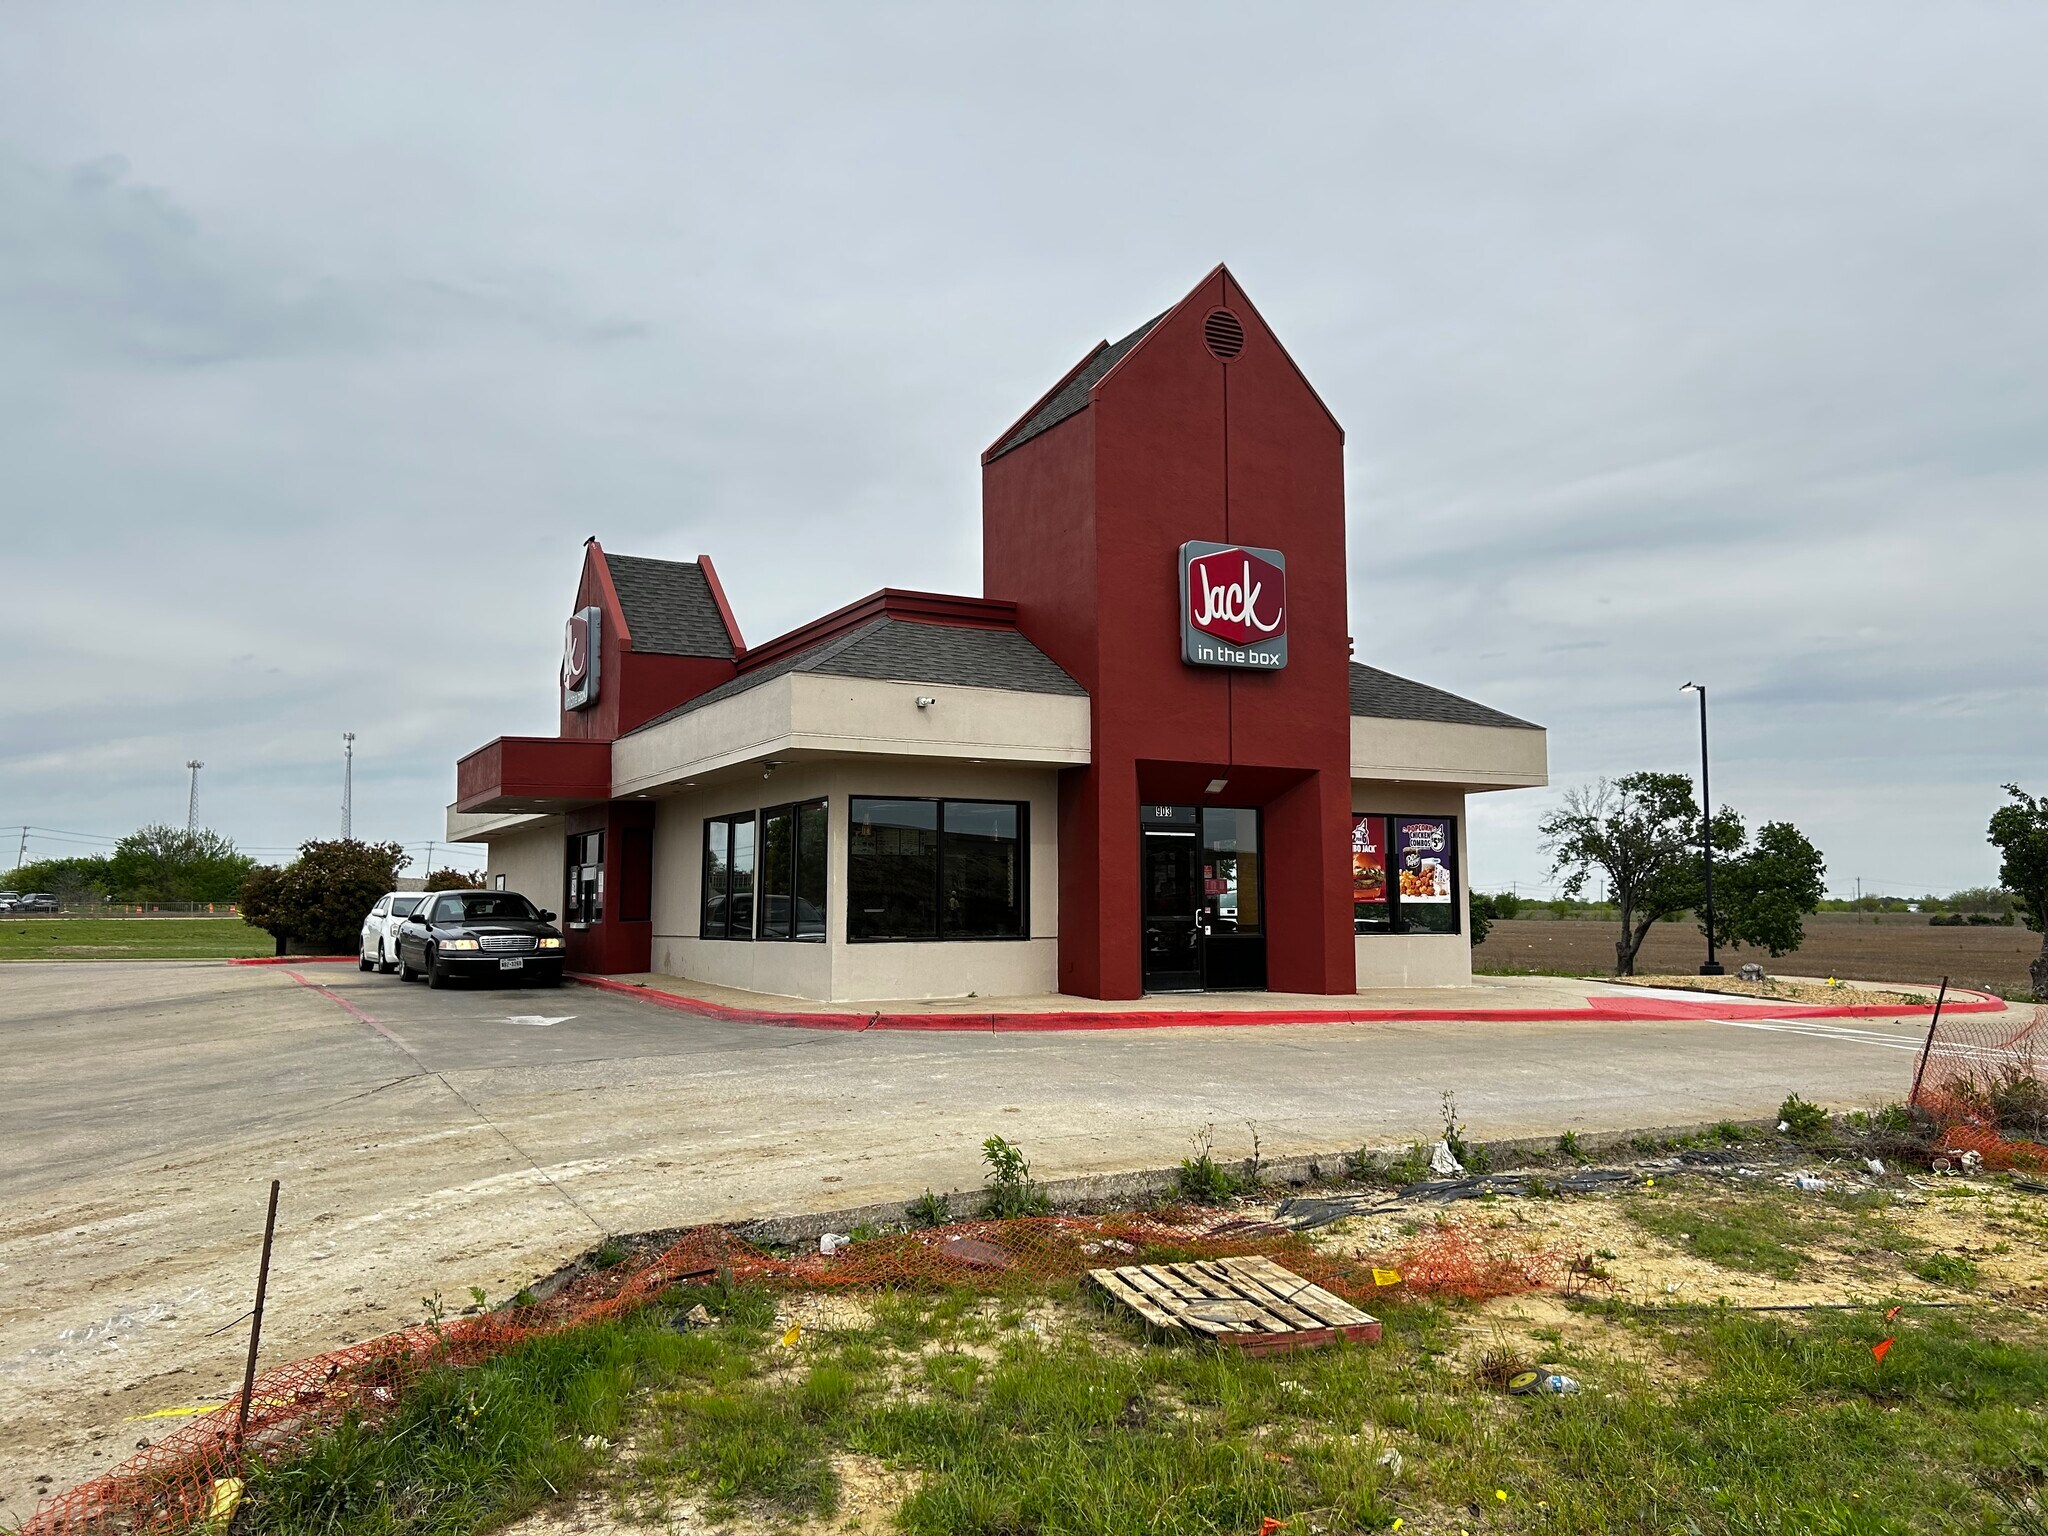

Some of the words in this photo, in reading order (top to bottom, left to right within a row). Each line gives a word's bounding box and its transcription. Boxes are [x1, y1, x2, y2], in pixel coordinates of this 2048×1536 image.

[1194, 560, 1282, 632] Jack
[1198, 644, 1213, 661] in
[1217, 646, 1245, 663] the
[1249, 649, 1279, 666] box
[1156, 806, 1171, 816] 903
[1407, 824, 1433, 832] POPCORN
